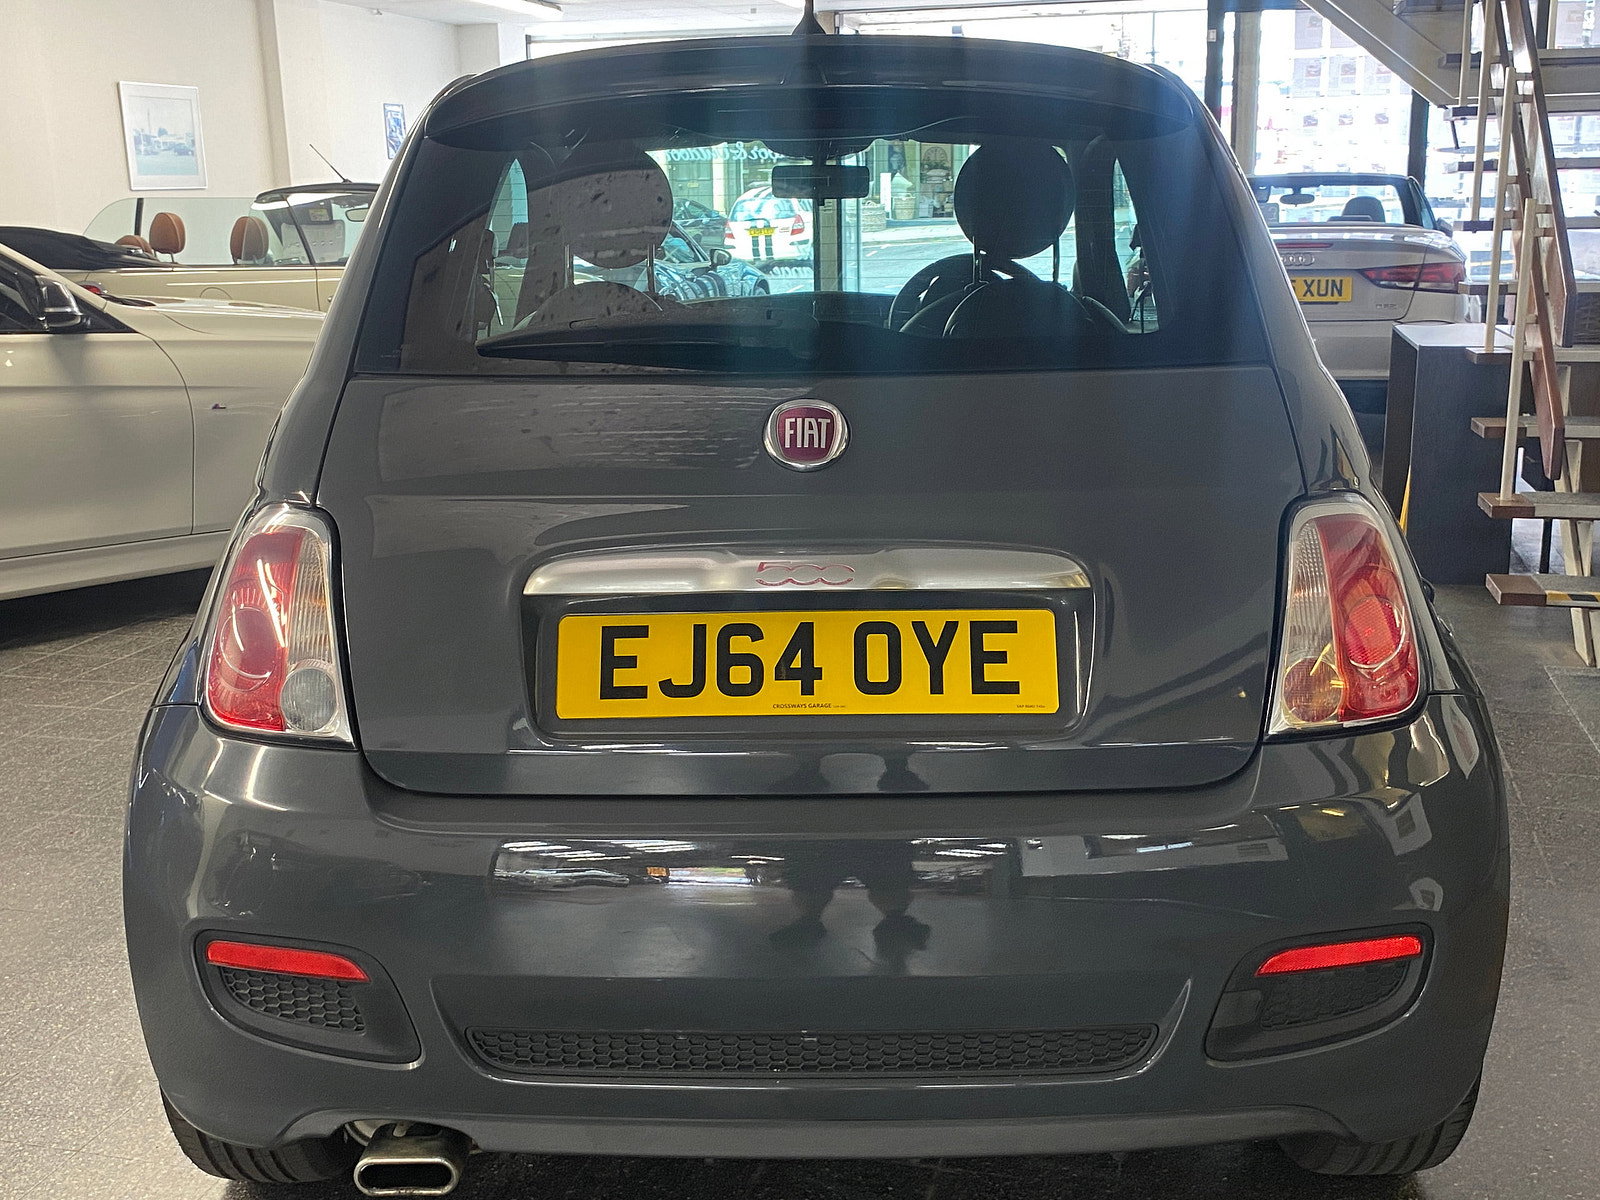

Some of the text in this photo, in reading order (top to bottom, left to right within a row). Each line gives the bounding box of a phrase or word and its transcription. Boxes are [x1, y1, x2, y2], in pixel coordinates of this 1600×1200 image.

[1302, 279, 1343, 297] XUN
[784, 418, 831, 449] FIAT
[755, 561, 855, 587] 500
[600, 620, 1020, 699] EJ64 OYE
